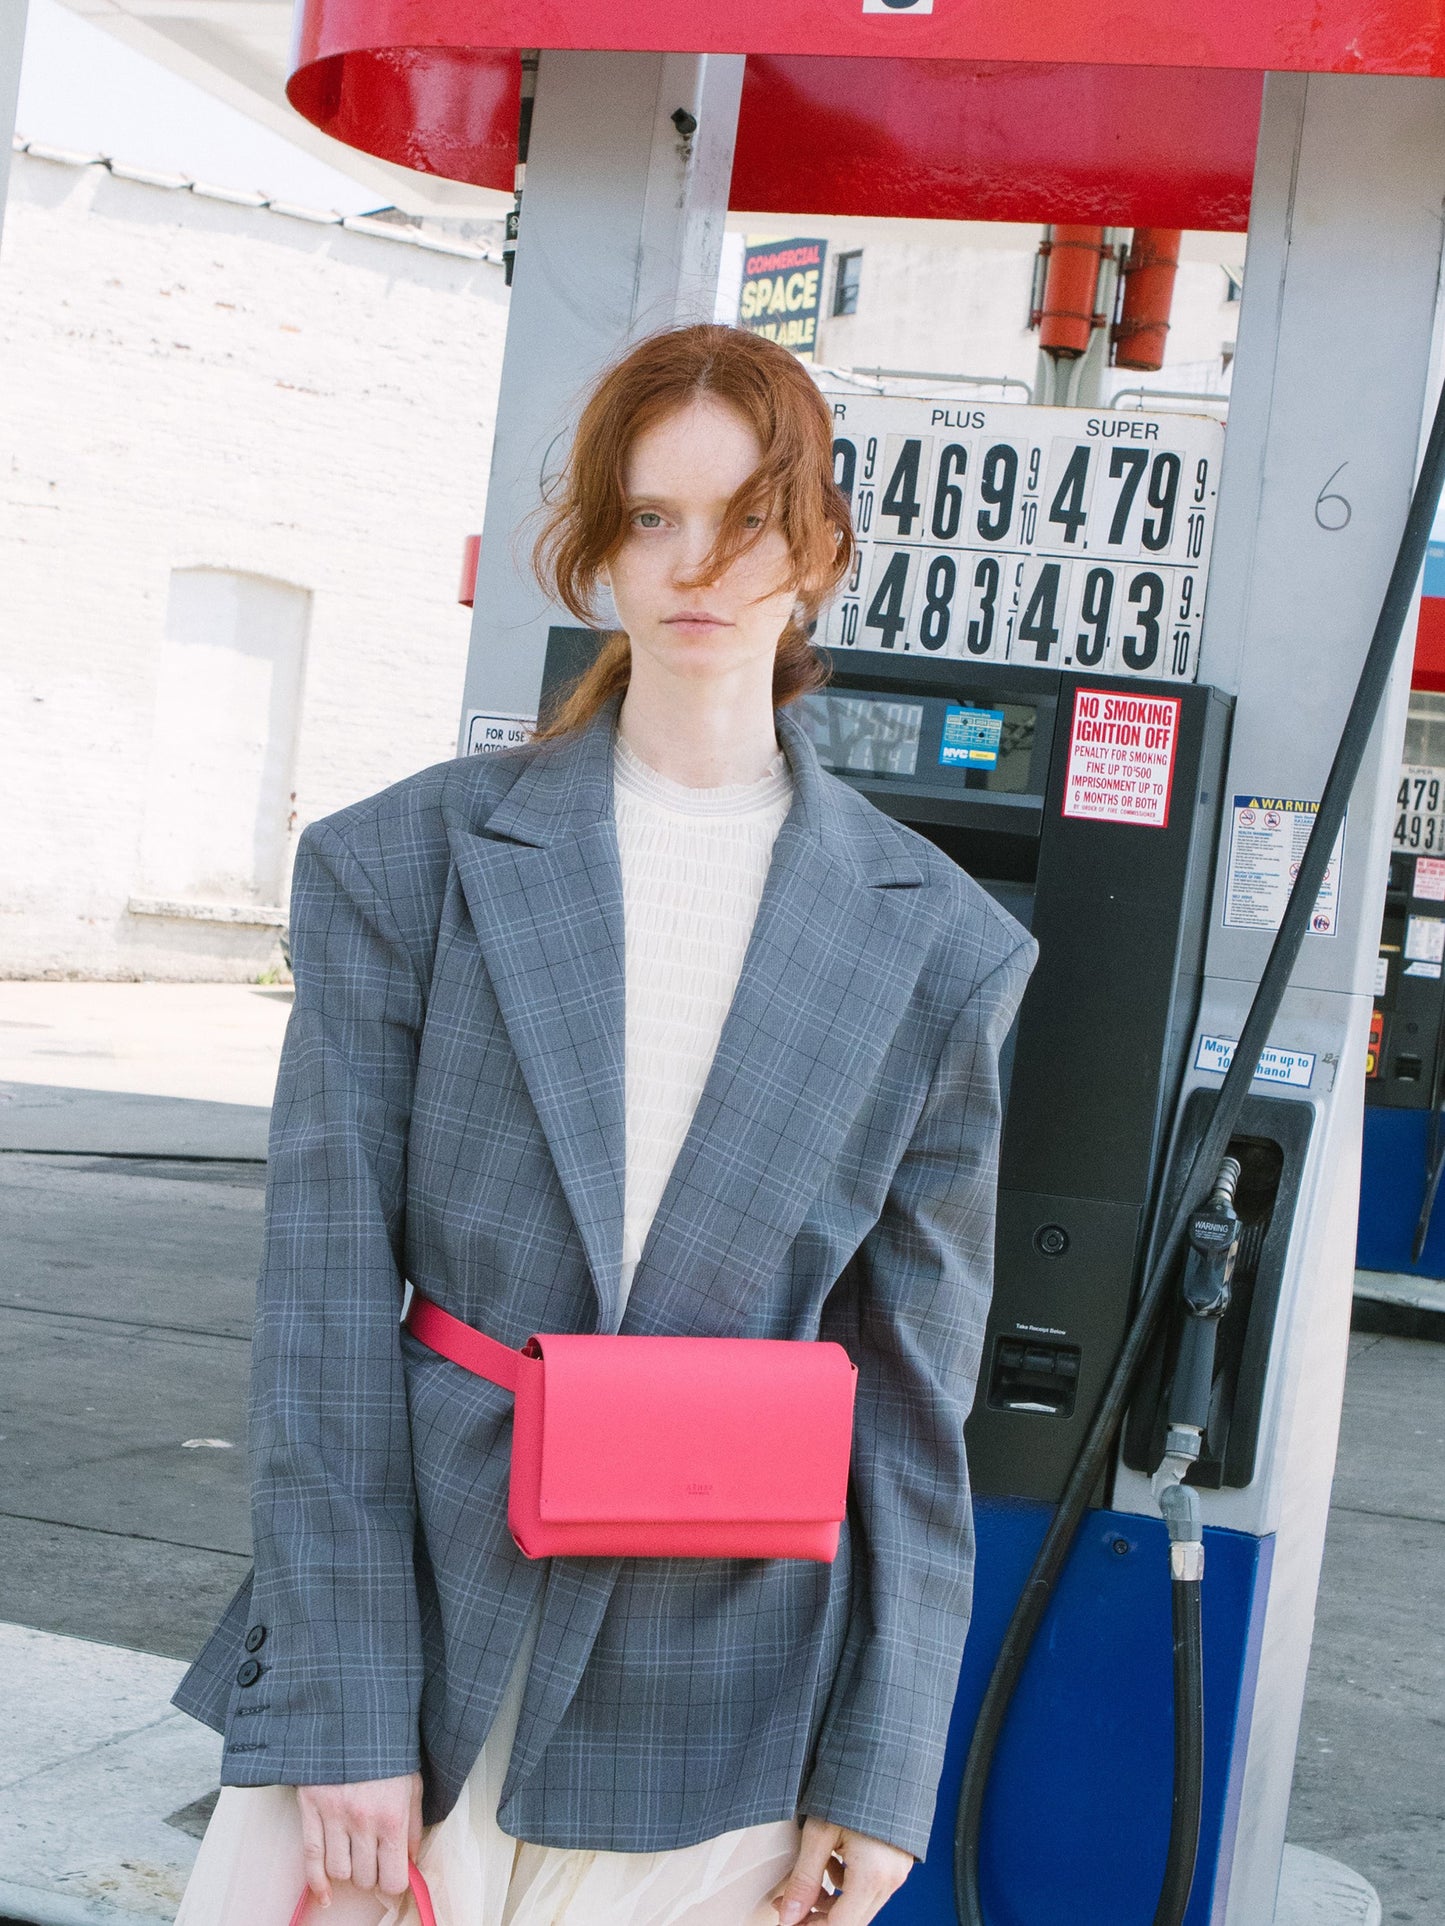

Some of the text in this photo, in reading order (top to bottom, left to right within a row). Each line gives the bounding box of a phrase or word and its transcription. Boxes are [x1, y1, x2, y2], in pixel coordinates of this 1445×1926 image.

[746, 245, 819, 276] COMMERCIAL
[742, 269, 819, 319] SPACE
[931, 409, 1159, 440] PLUS SUPER
[1048, 445, 1181, 551] 4.79
[1315, 461, 1352, 531] 6
[865, 552, 1000, 655] 4.83
[1079, 697, 1172, 726] NO SMOKING
[485, 728, 525, 743] FOR USE
[1076, 720, 1171, 750] IGNITION OFF
[943, 747, 968, 759] NYC
[1074, 745, 1168, 766] PENALTY FOR SMOKING
[1086, 761, 1106, 774] FINE
[1108, 763, 1120, 776] UP
[1123, 765, 1133, 777] TO
[1071, 775, 1164, 796] IMPRISONMENT UP TO
[1397, 777, 1440, 811] 479
[1074, 791, 1158, 810] 6 MONTHS OR BOTH
[1261, 798, 1320, 813] WARNIN
[1394, 814, 1435, 849] 493
[1205, 1040, 1230, 1056] May
[1280, 1055, 1294, 1067] up
[1297, 1057, 1309, 1068] to
[1217, 1057, 1290, 1078] 10 hanol
[1195, 1221, 1229, 1233] WARNING
